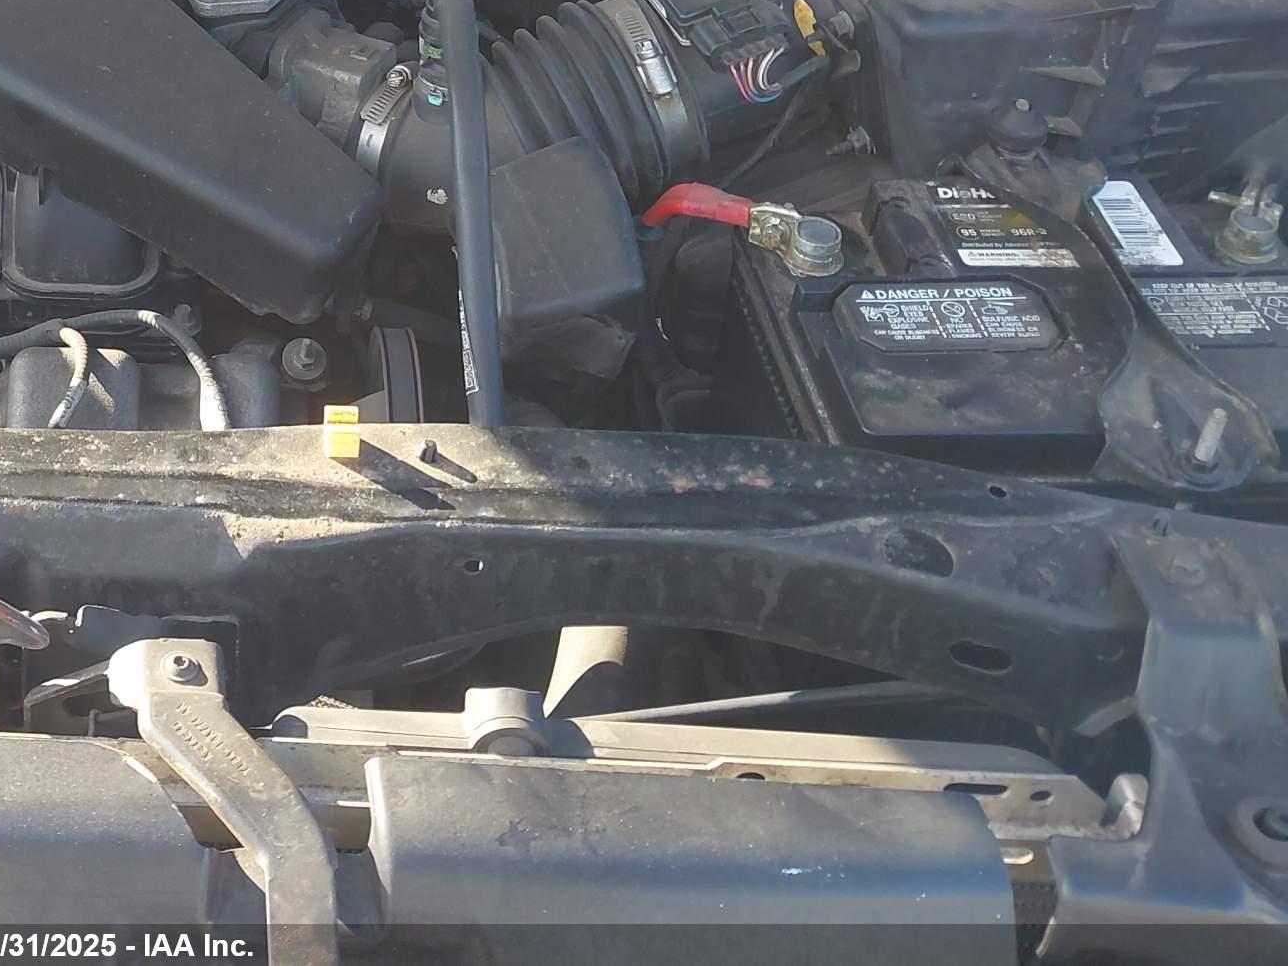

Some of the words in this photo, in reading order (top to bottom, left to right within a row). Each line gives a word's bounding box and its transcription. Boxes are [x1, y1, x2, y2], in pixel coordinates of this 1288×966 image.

[874, 289, 939, 299] DANGER
[943, 289, 950, 298] /
[954, 287, 1013, 298] POISON
